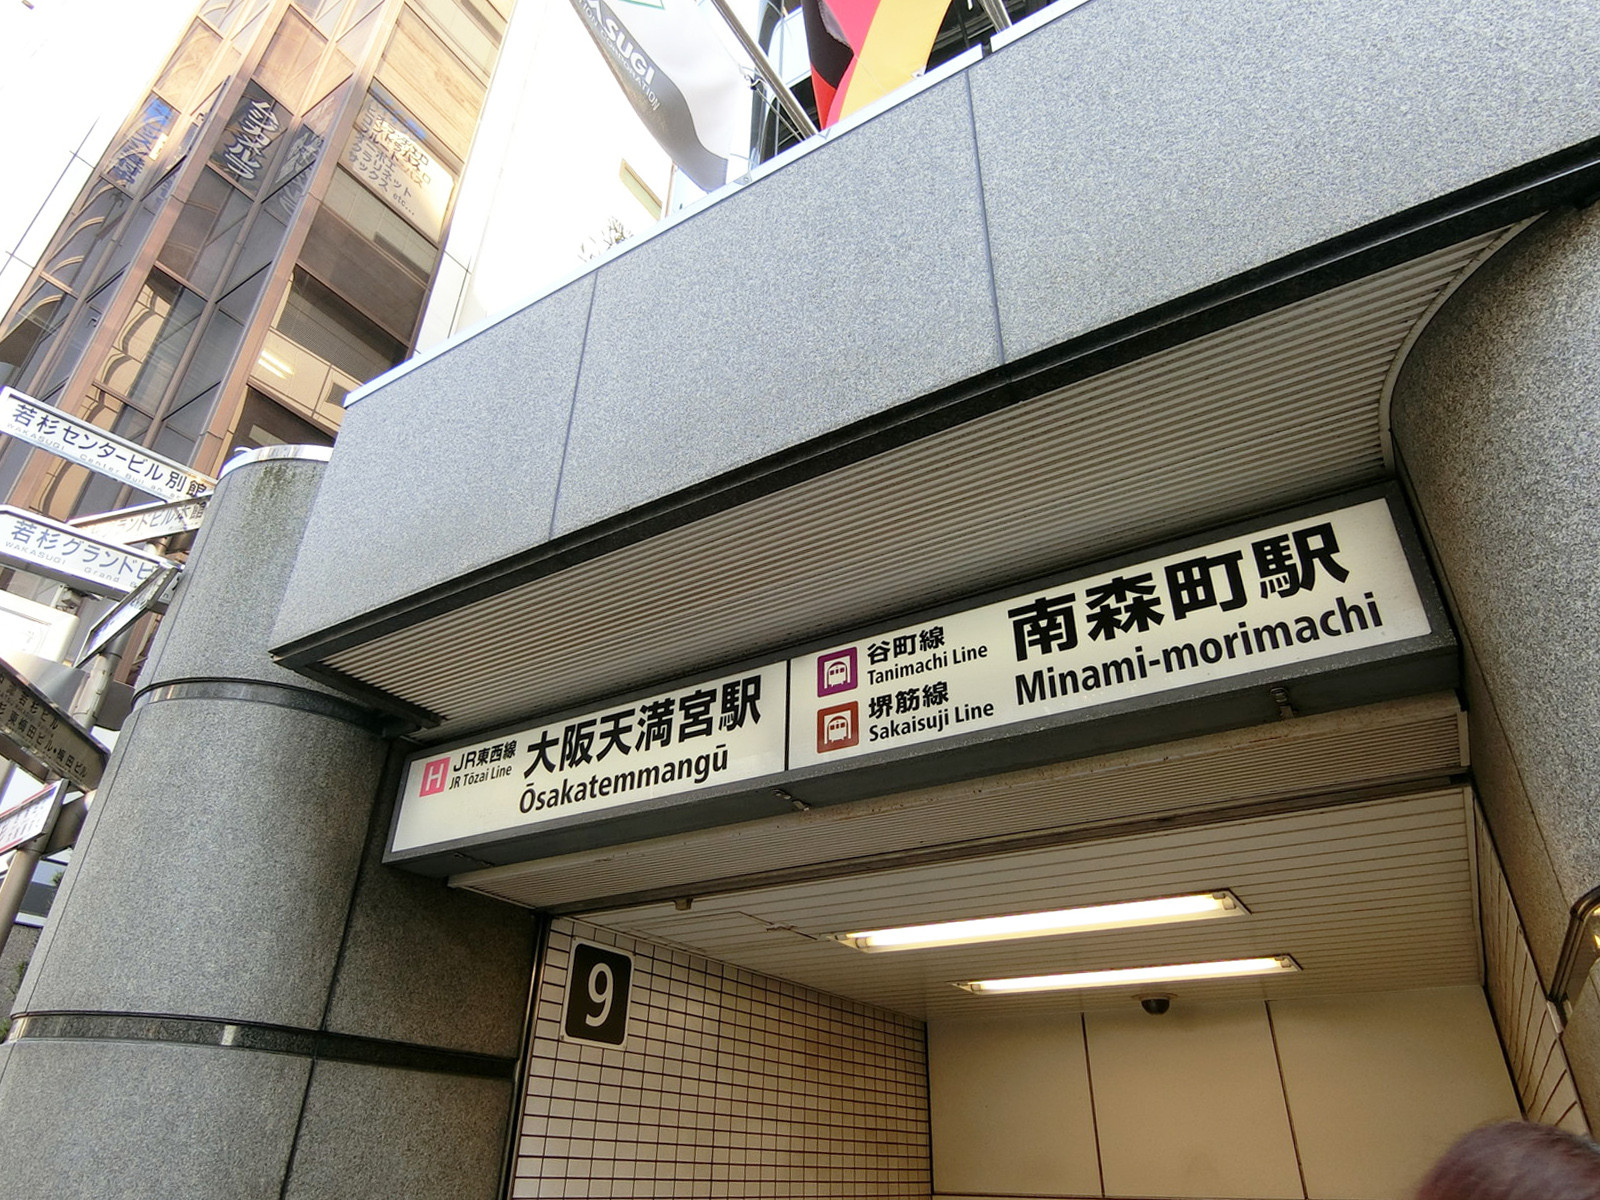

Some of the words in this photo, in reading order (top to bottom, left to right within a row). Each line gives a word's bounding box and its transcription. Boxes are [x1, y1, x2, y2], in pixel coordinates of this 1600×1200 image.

[5, 541, 66, 565] WAKASUGI
[84, 566, 120, 583] Grand
[1007, 522, 1349, 662] 南森町駅
[867, 626, 945, 665] 谷町線
[867, 652, 948, 685] Tanimachi
[953, 644, 988, 665] Line
[1014, 592, 1383, 705] Minami-morimachi
[868, 681, 949, 719] 堺筋線
[523, 674, 762, 779] 大阪天満宮駅
[869, 711, 949, 742] Sakaisuji
[955, 703, 994, 723] Line
[453, 740, 517, 772] JR東西線
[449, 776, 461, 790] JR
[463, 769, 488, 786] Tōzai
[491, 765, 512, 780] Line
[519, 744, 729, 814] Ōsakatemmangū
[585, 962, 614, 1027] 9
